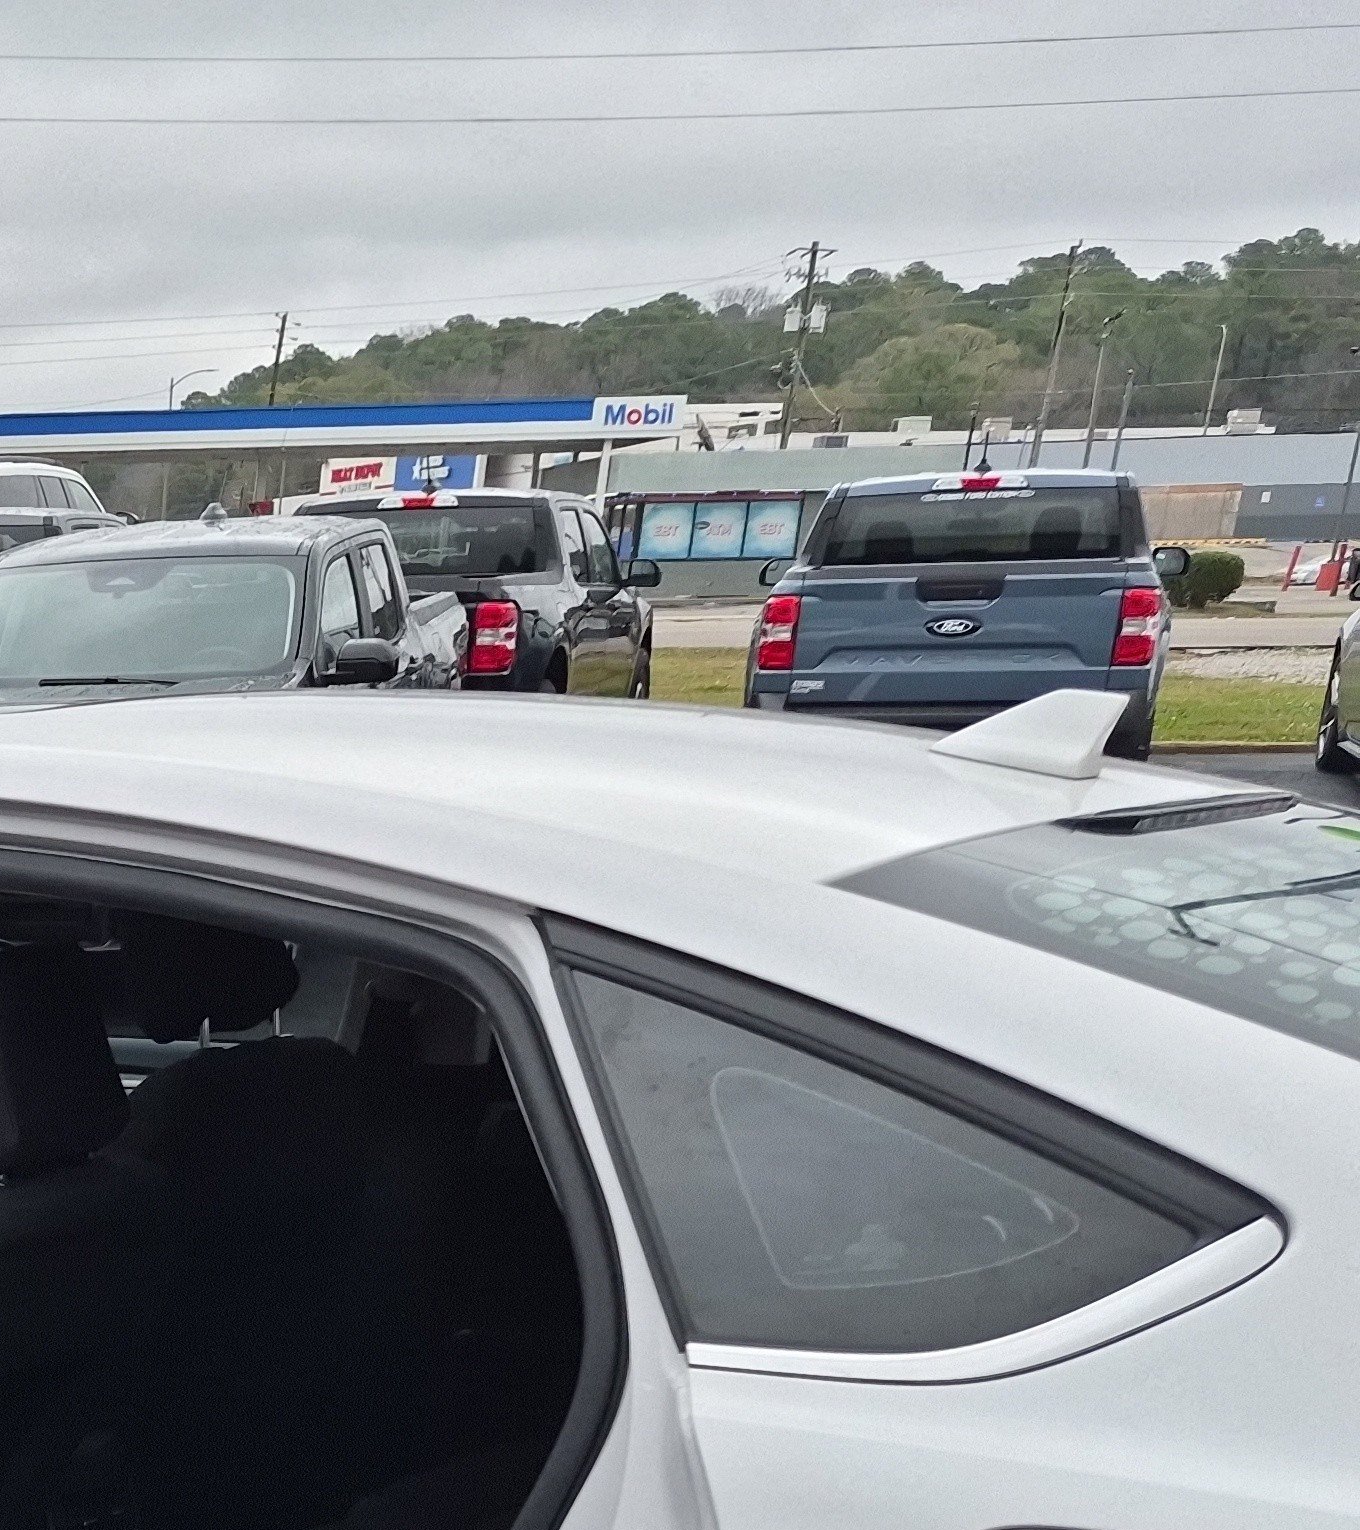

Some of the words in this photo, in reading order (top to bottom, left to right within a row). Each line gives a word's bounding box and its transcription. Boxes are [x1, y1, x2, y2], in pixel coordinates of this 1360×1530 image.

[603, 402, 675, 426] Mobil
[653, 524, 680, 537] EBT
[758, 522, 786, 536] EBT
